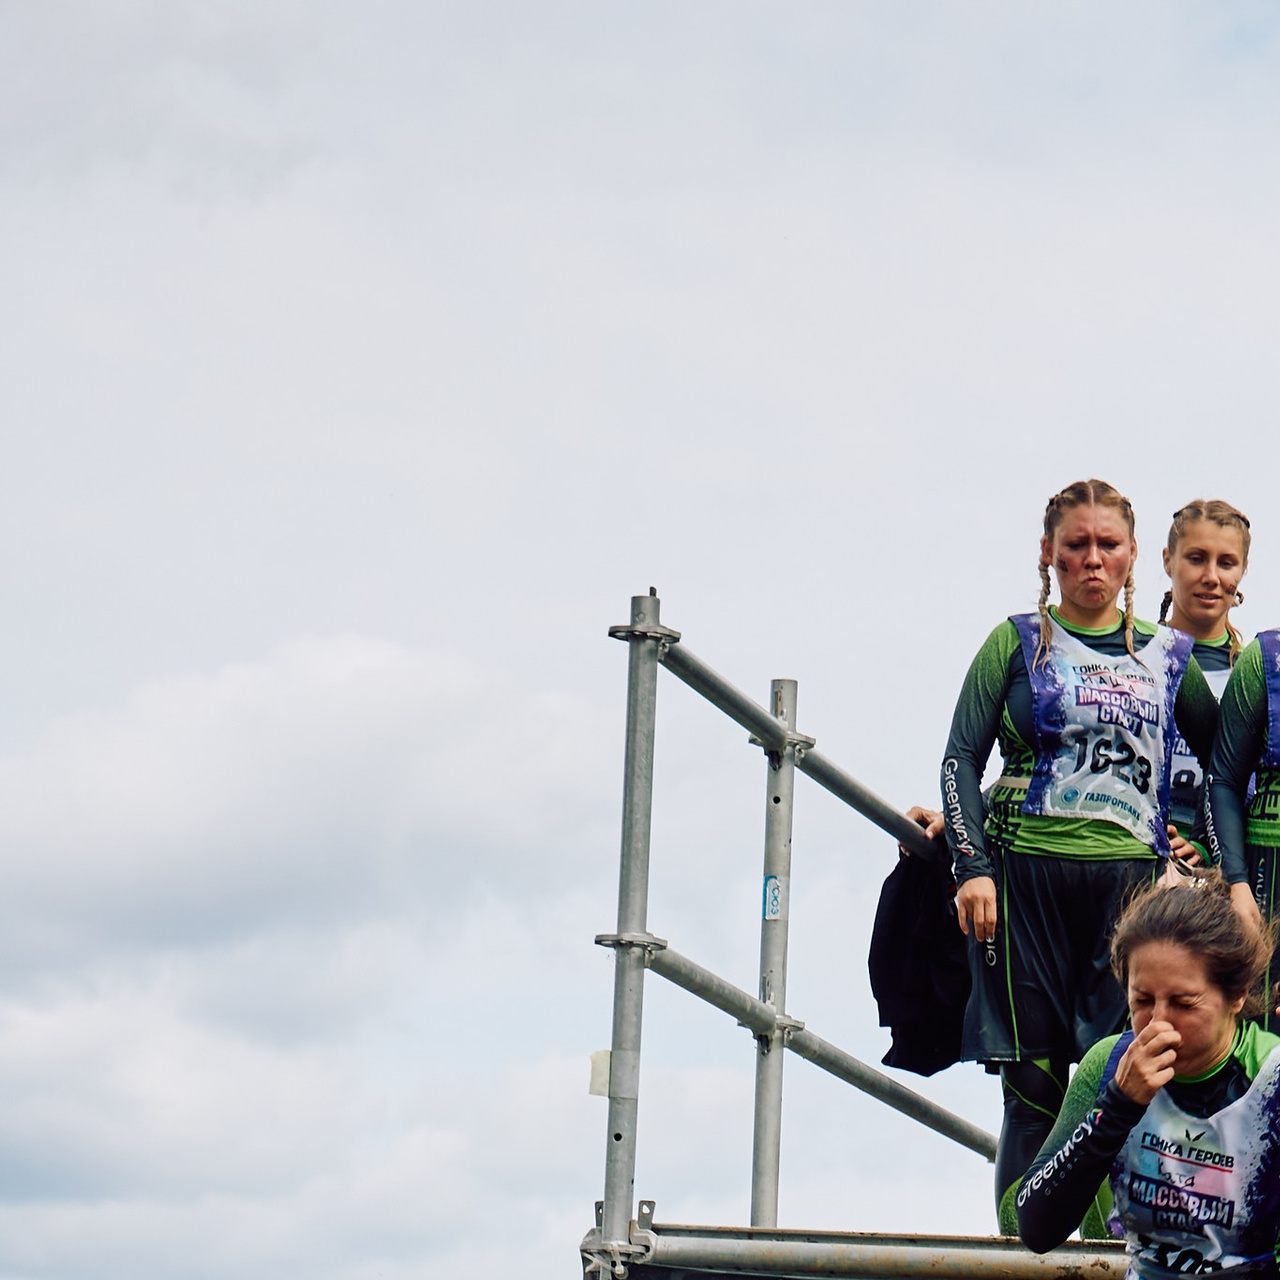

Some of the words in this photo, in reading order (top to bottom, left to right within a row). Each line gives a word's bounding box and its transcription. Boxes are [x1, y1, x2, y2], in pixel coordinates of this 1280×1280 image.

[1078, 687, 1158, 723] МАССОВЫЙ
[1100, 705, 1141, 732] СТАРТ
[1073, 737, 1152, 795] 1623
[944, 758, 975, 854] Greenway
[1141, 1131, 1184, 1158] ГОНКА
[1187, 1147, 1235, 1168] ГЕРОЕВ
[1132, 1179, 1230, 1225] МАССОВЫЙ
